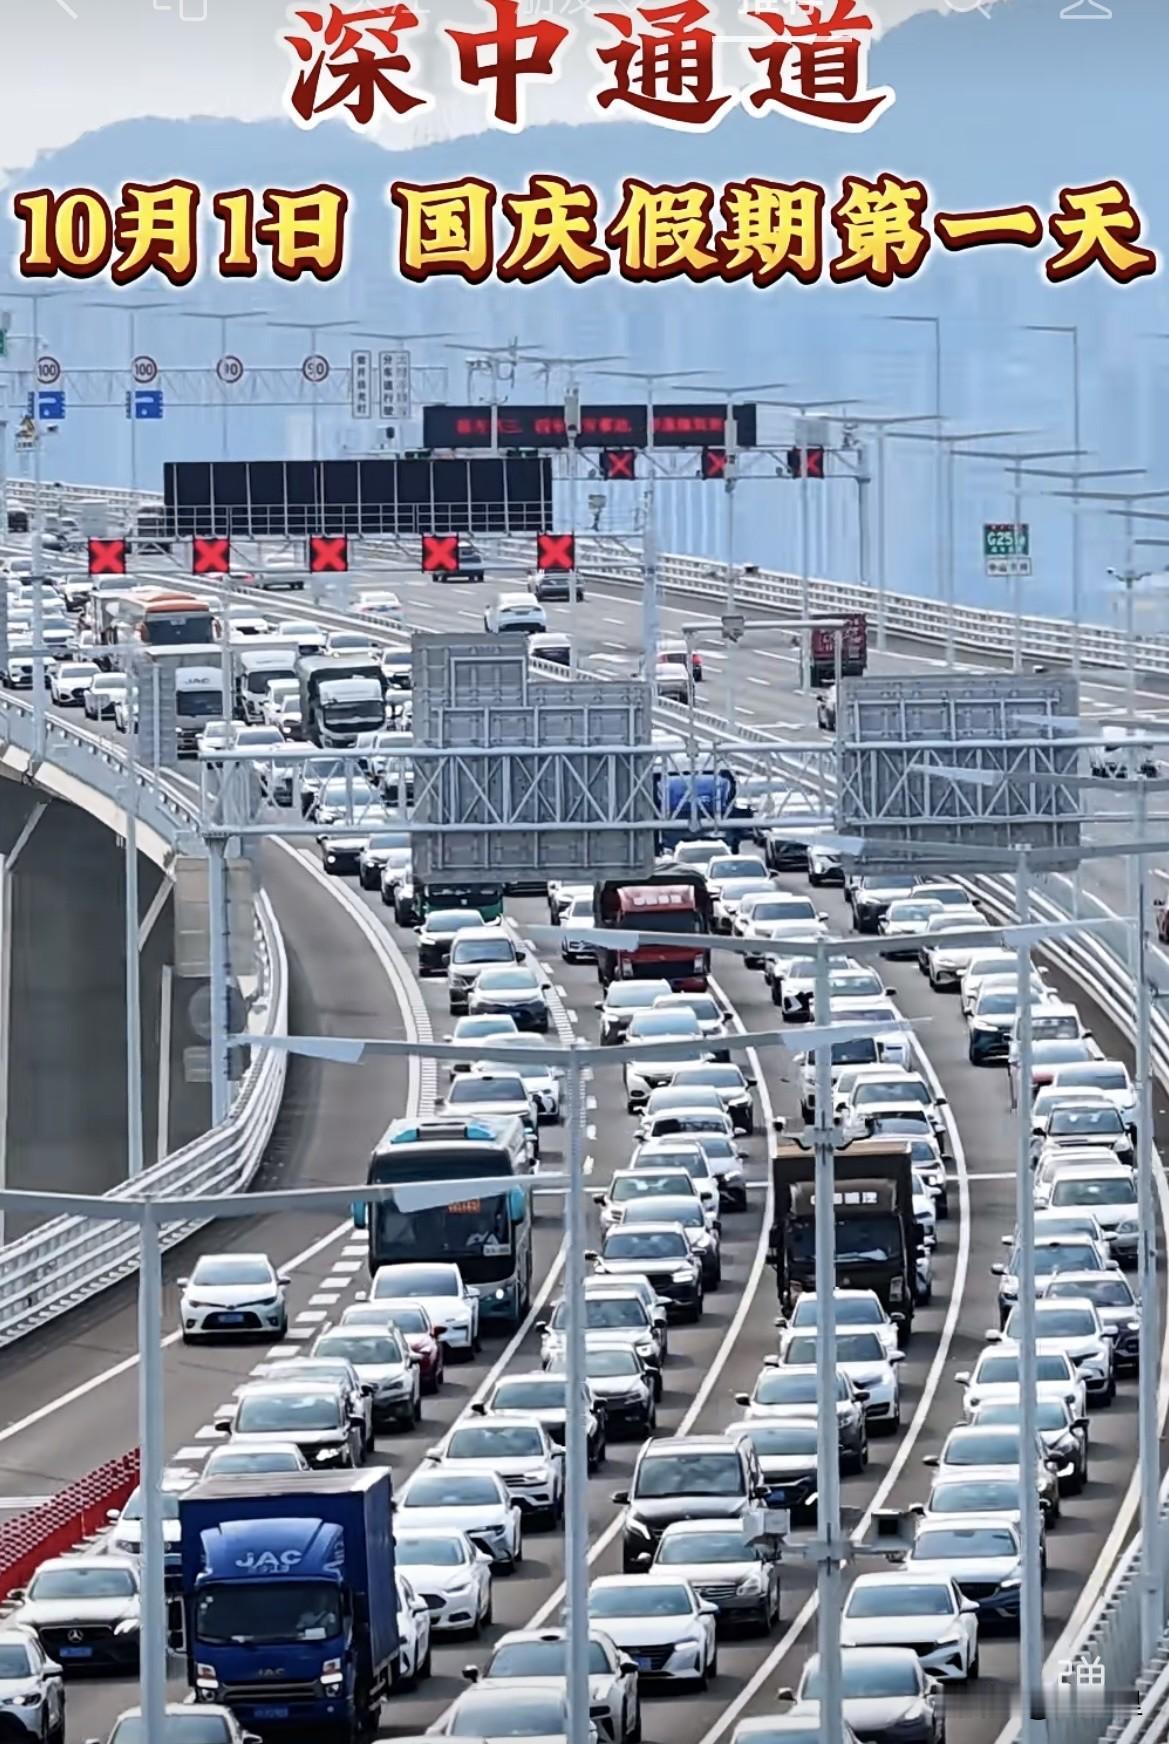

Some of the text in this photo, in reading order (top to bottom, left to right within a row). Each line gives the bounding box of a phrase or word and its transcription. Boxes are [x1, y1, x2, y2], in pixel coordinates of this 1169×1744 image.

[38, 364, 57, 376] 100
[134, 363, 153, 376] 100
[235, 1550, 302, 1568] JAC
